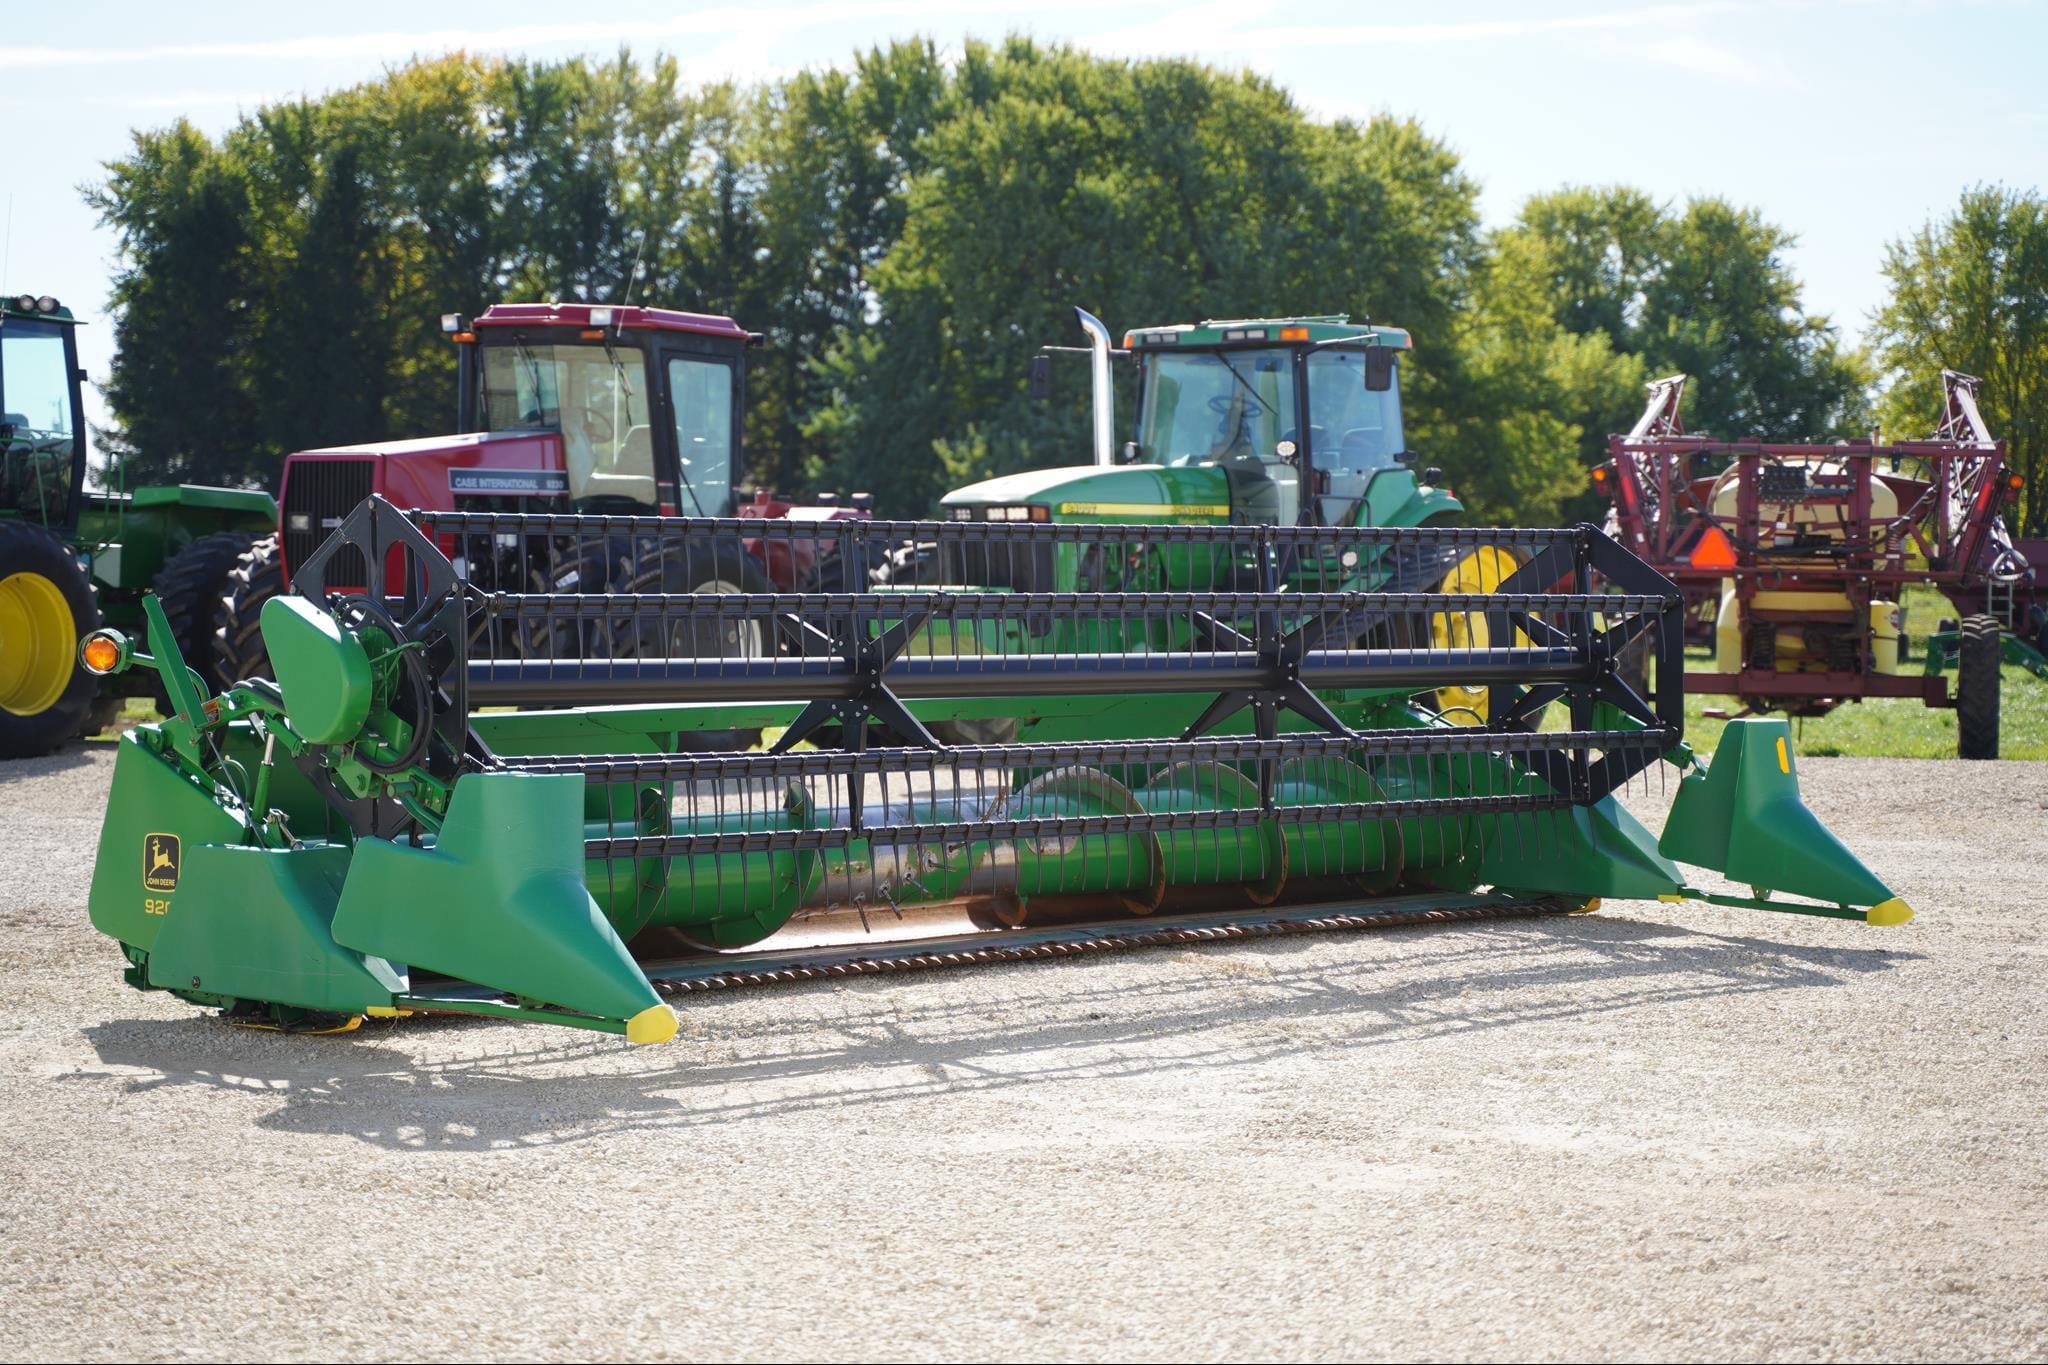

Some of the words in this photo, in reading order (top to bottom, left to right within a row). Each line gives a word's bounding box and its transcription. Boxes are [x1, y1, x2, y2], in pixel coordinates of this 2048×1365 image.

[455, 478, 478, 488] CASE
[479, 478, 538, 489] INTERNATIONAL
[147, 877, 160, 885] JOHN
[160, 878, 175, 886] DEERE
